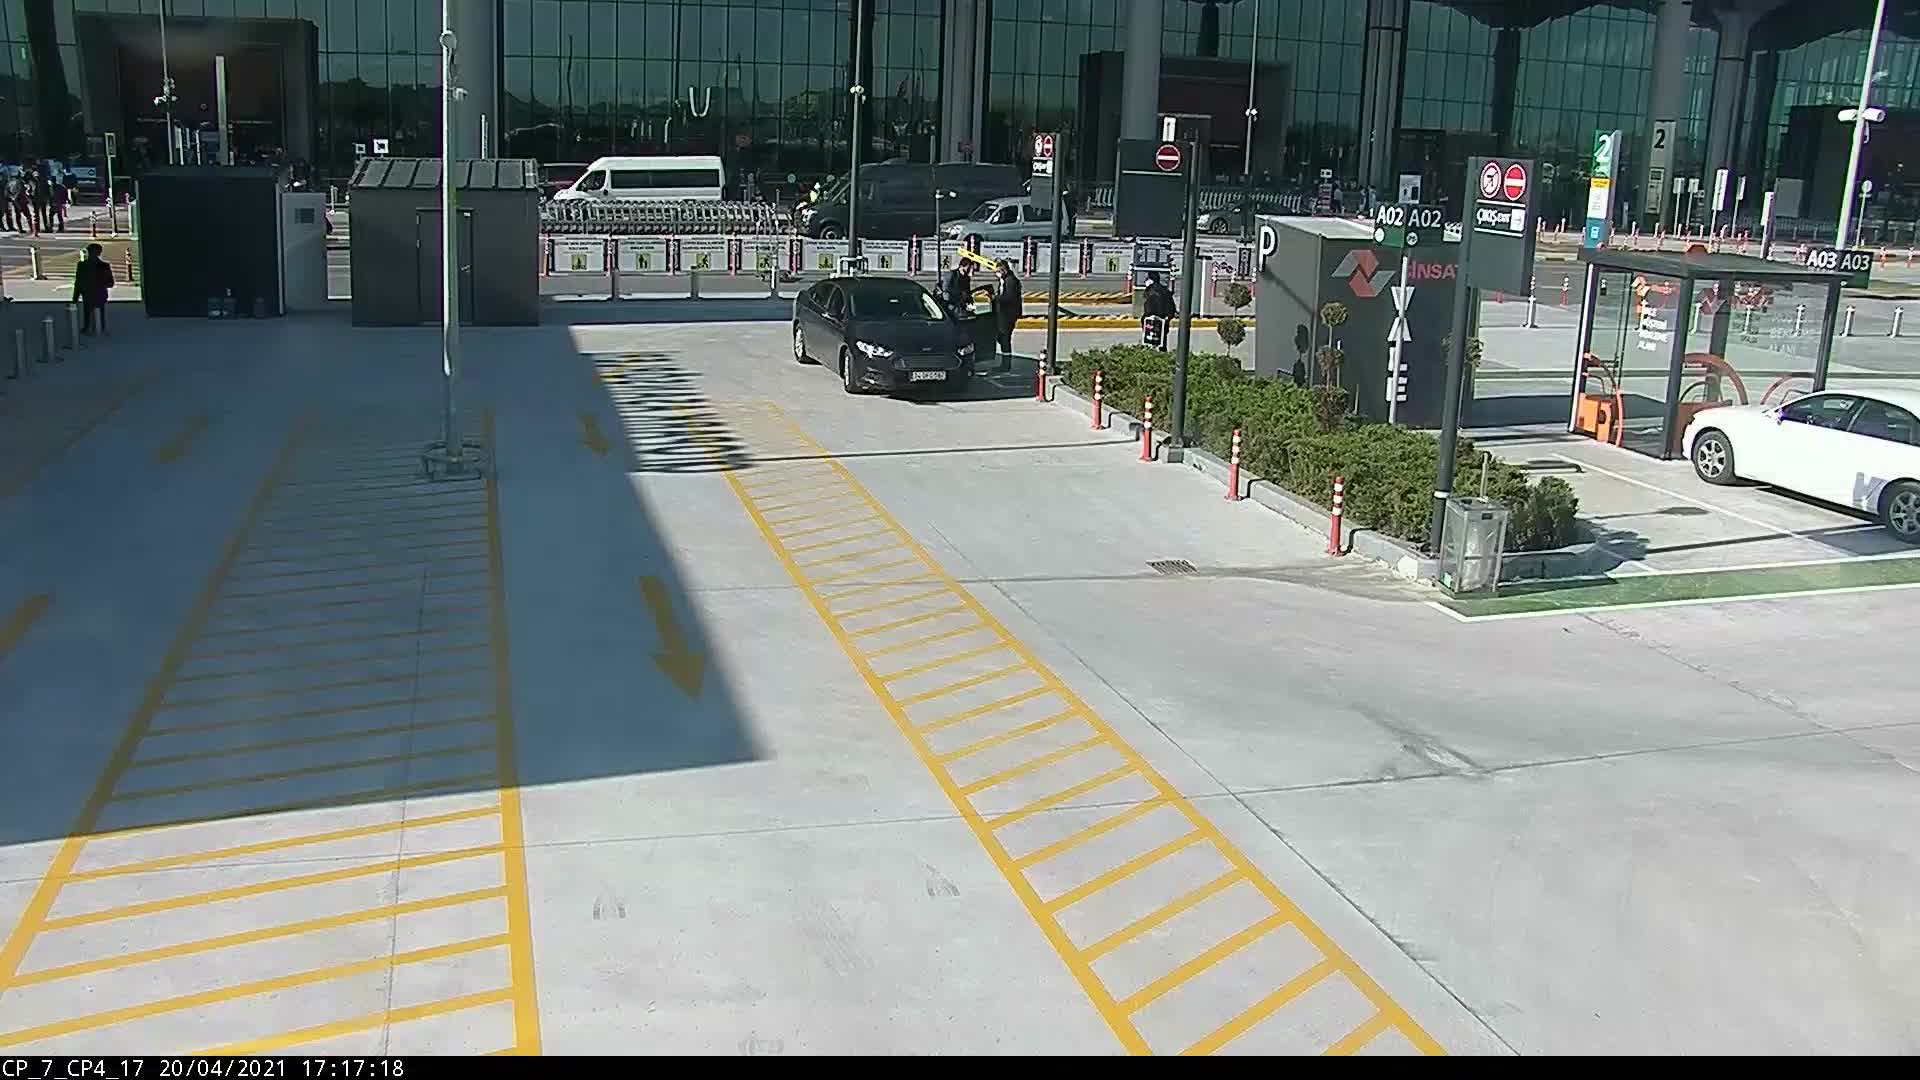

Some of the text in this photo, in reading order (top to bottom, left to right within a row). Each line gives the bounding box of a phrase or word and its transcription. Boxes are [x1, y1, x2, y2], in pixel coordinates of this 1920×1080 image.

[1592, 133, 1611, 162] 2
[1652, 128, 1665, 149] 2
[1376, 204, 1404, 226] A02
[1408, 208, 1442, 228] A02
[1258, 225, 1276, 272] P
[1806, 249, 1838, 269] A03
[1840, 253, 1870, 271] A03
